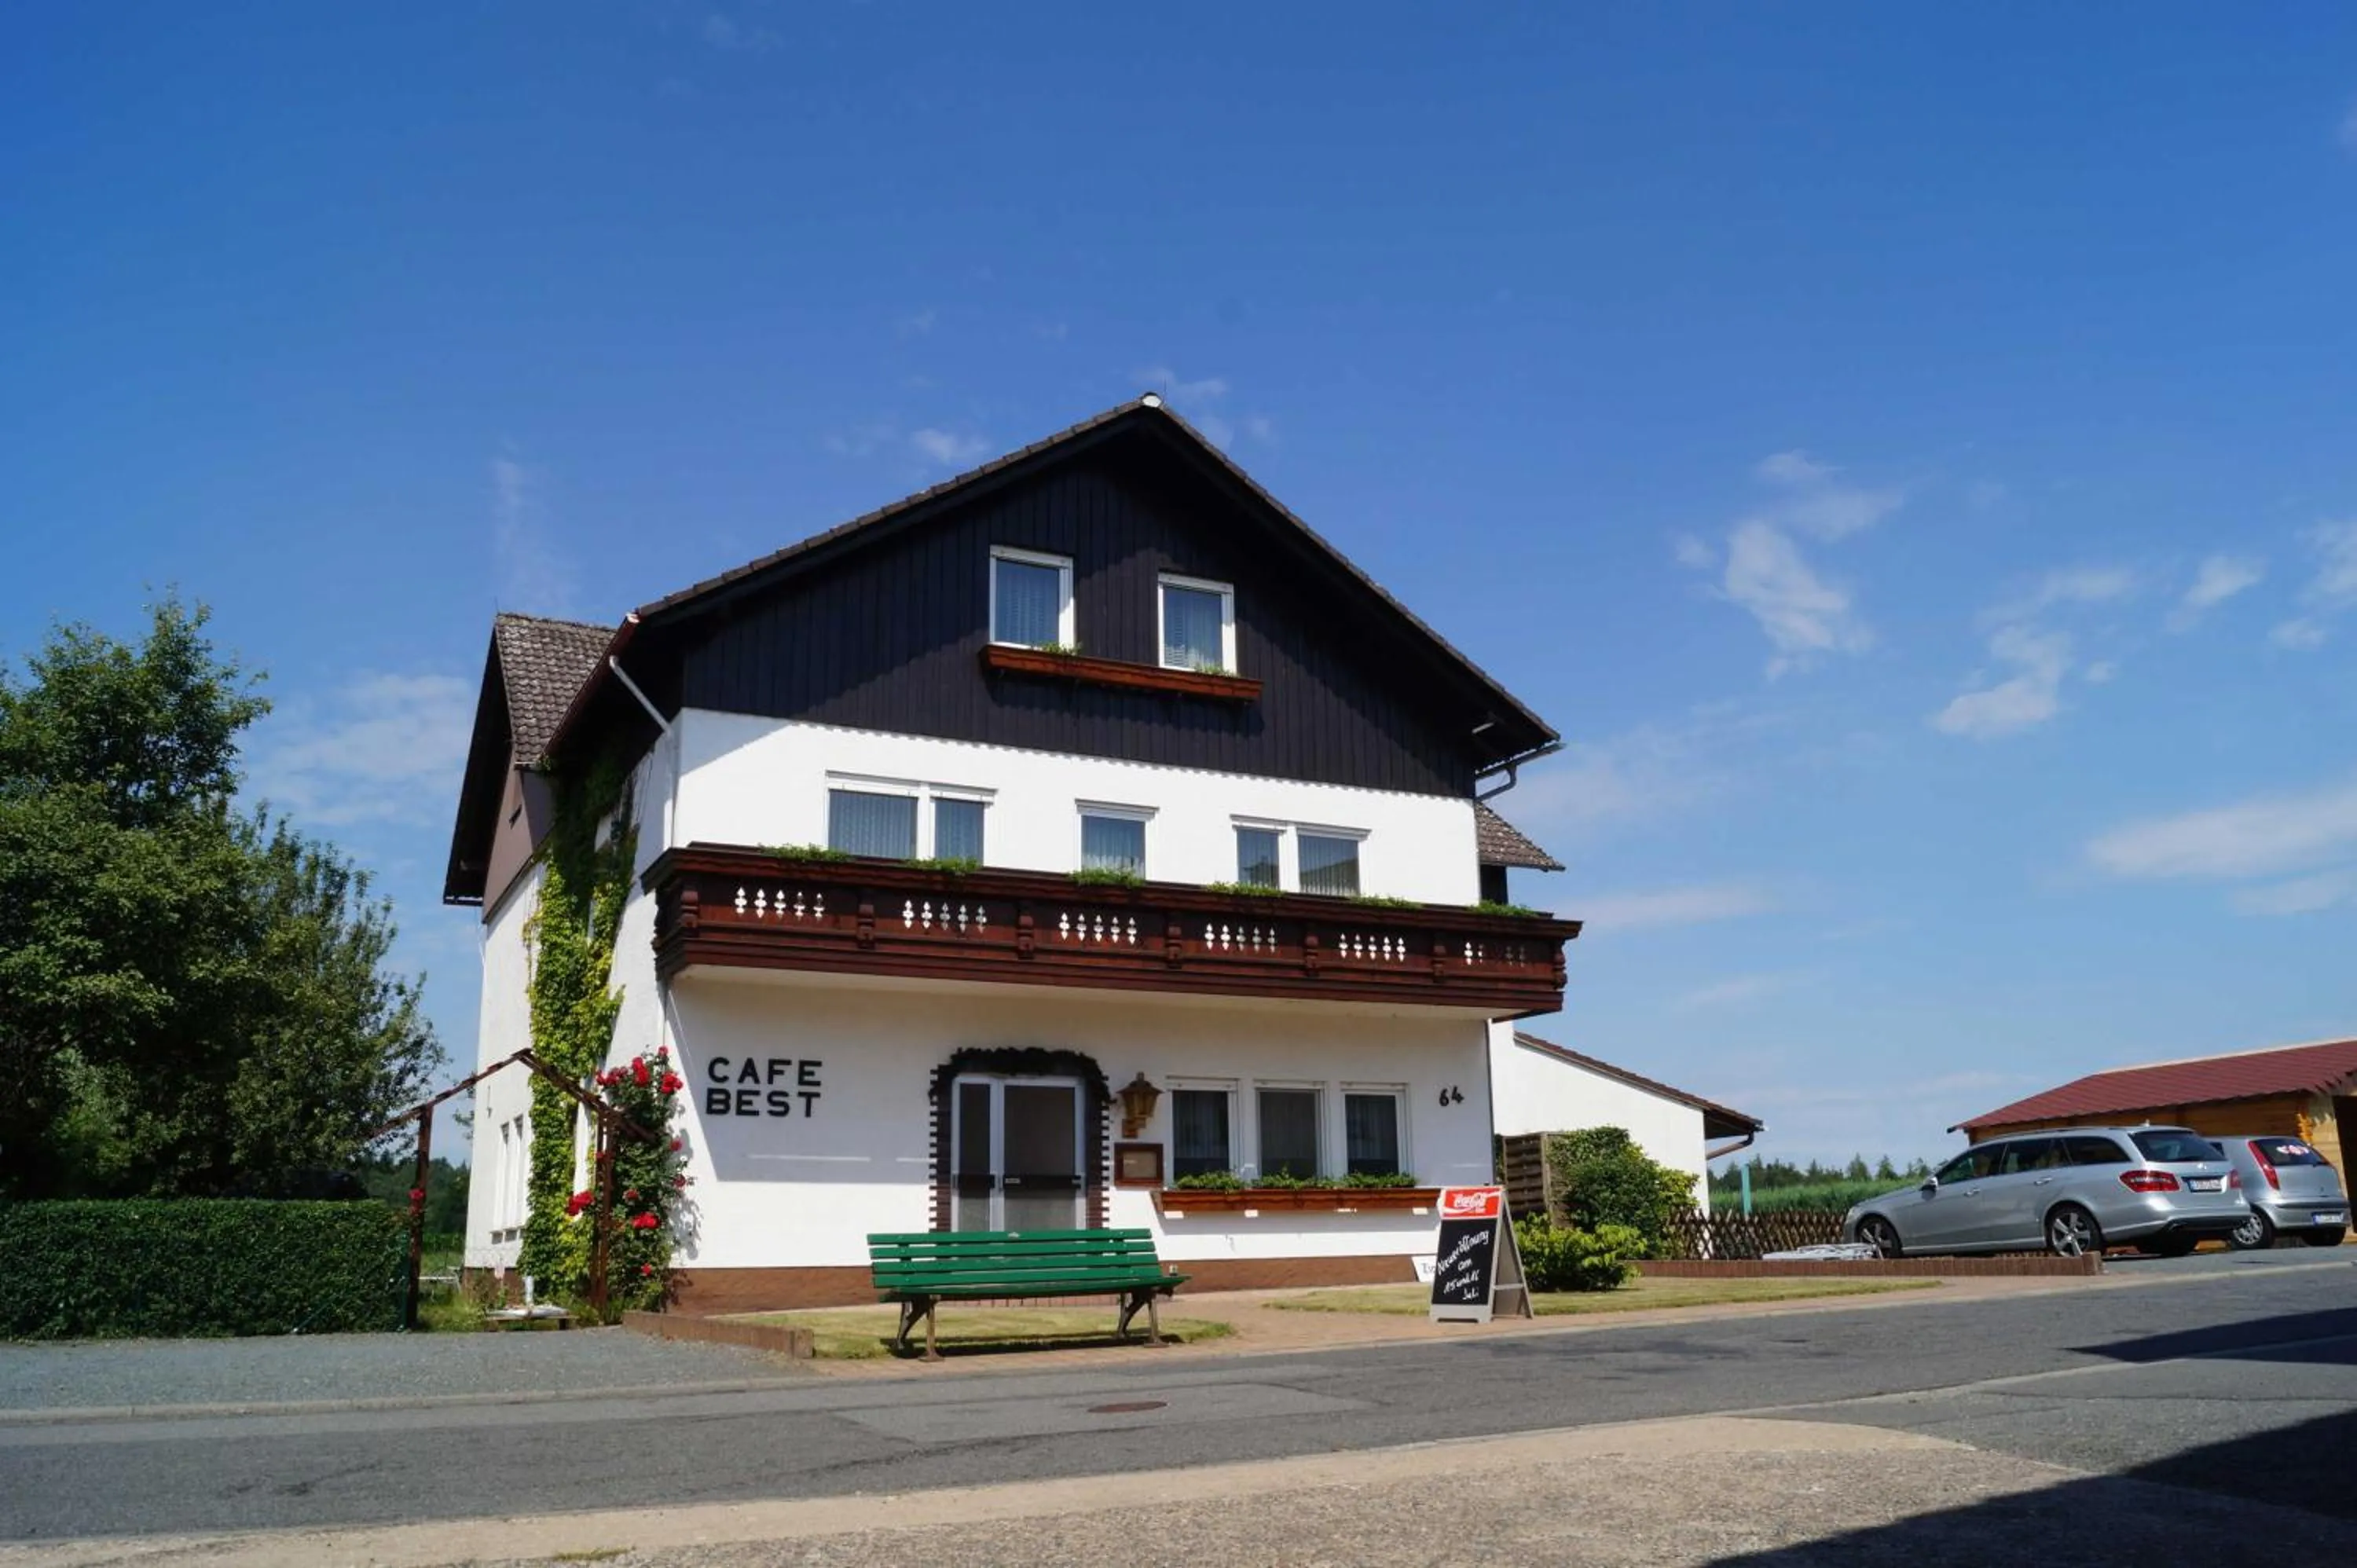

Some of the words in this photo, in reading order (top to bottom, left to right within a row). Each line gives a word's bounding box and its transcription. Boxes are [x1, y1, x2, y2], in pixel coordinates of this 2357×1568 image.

[707, 1057, 823, 1087] CAFE
[706, 1087, 821, 1118] BEST
[1439, 1086, 1464, 1107] 64
